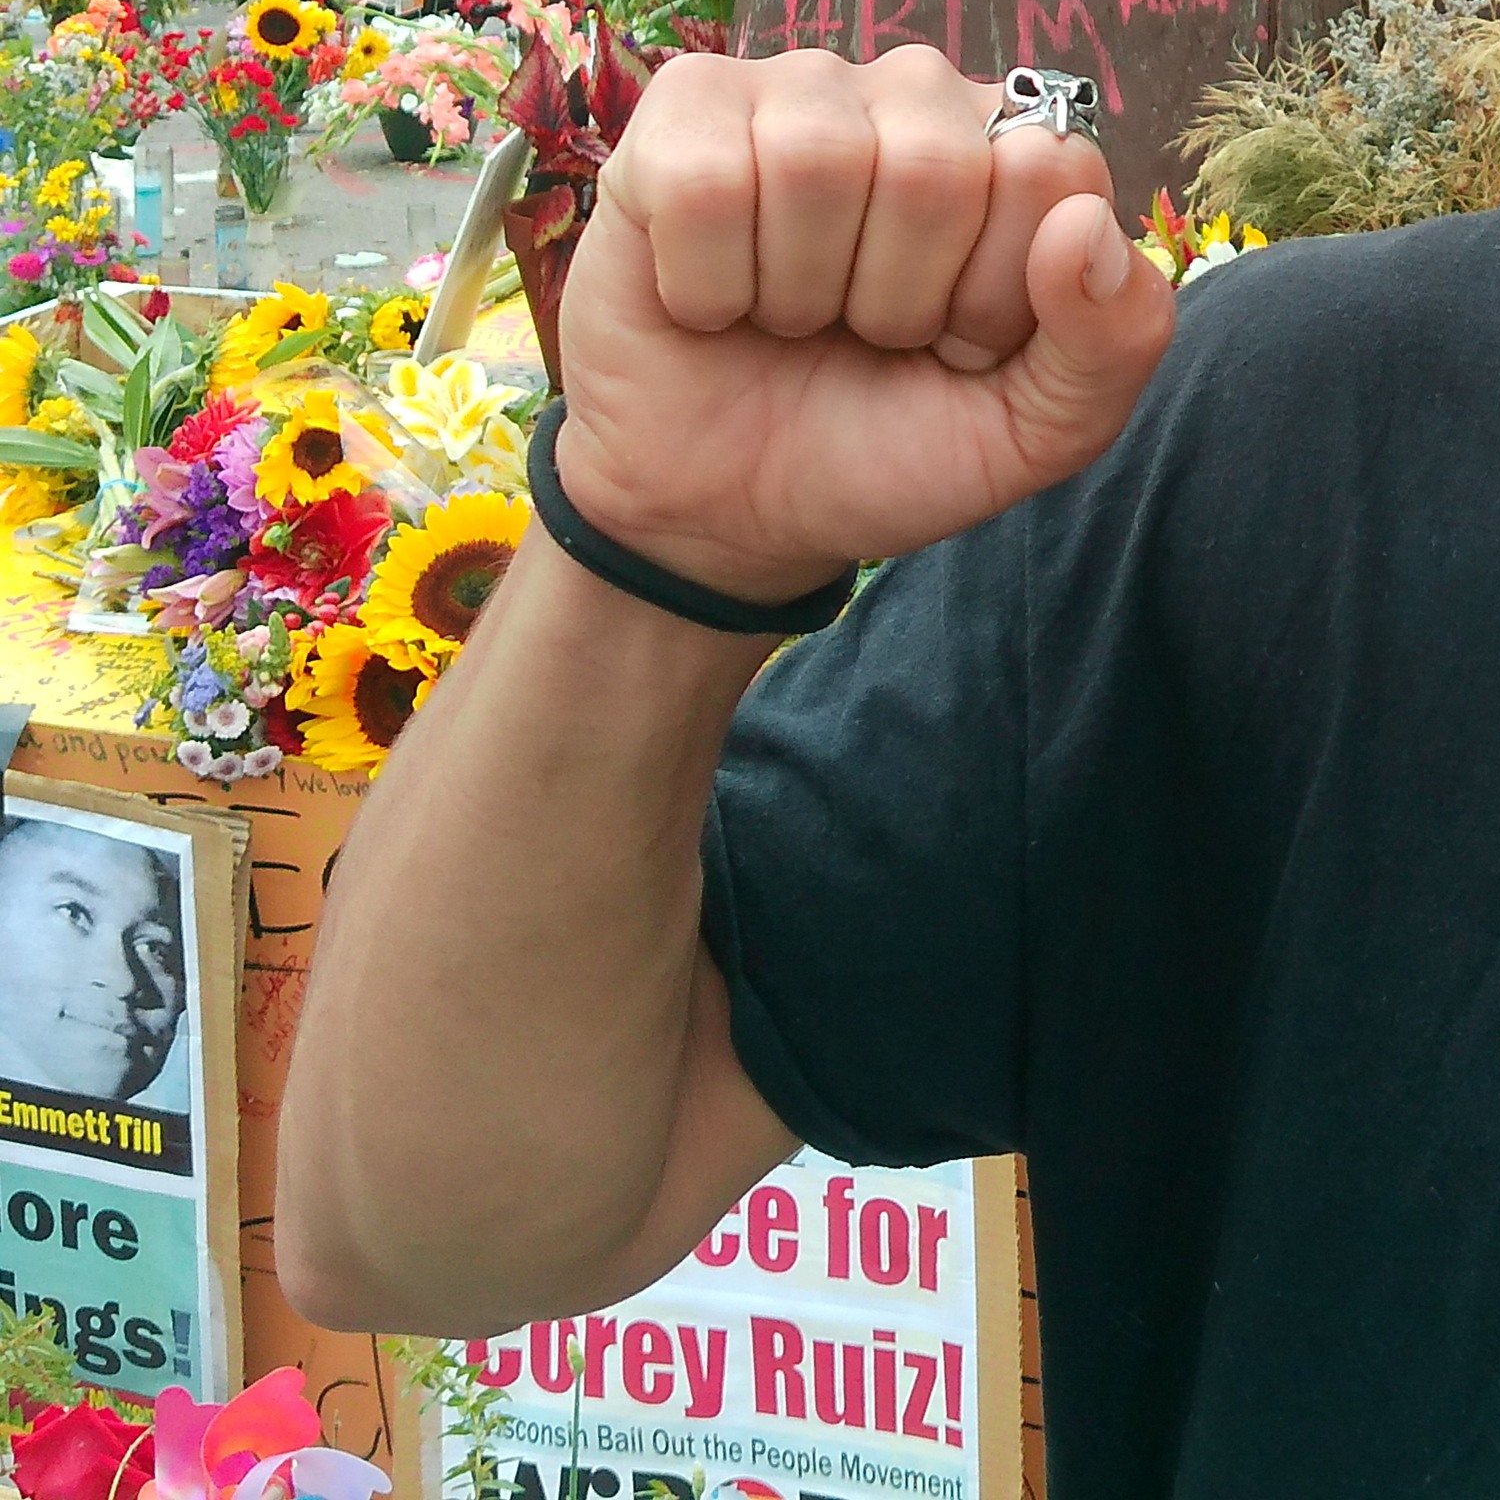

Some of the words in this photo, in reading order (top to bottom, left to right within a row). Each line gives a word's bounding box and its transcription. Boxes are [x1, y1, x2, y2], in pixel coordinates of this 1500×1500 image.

[0, 1091, 110, 1145] Emmett
[115, 1113, 163, 1156] Till
[2, 1190, 140, 1261] ore
[823, 1175, 948, 1292] for
[750, 1315, 964, 1449] Ruiz!
[597, 1423, 643, 1454] Bail
[652, 1428, 696, 1459] Out
[704, 1430, 742, 1464] the
[752, 1443, 832, 1478] People
[841, 1451, 963, 1500] Movement
